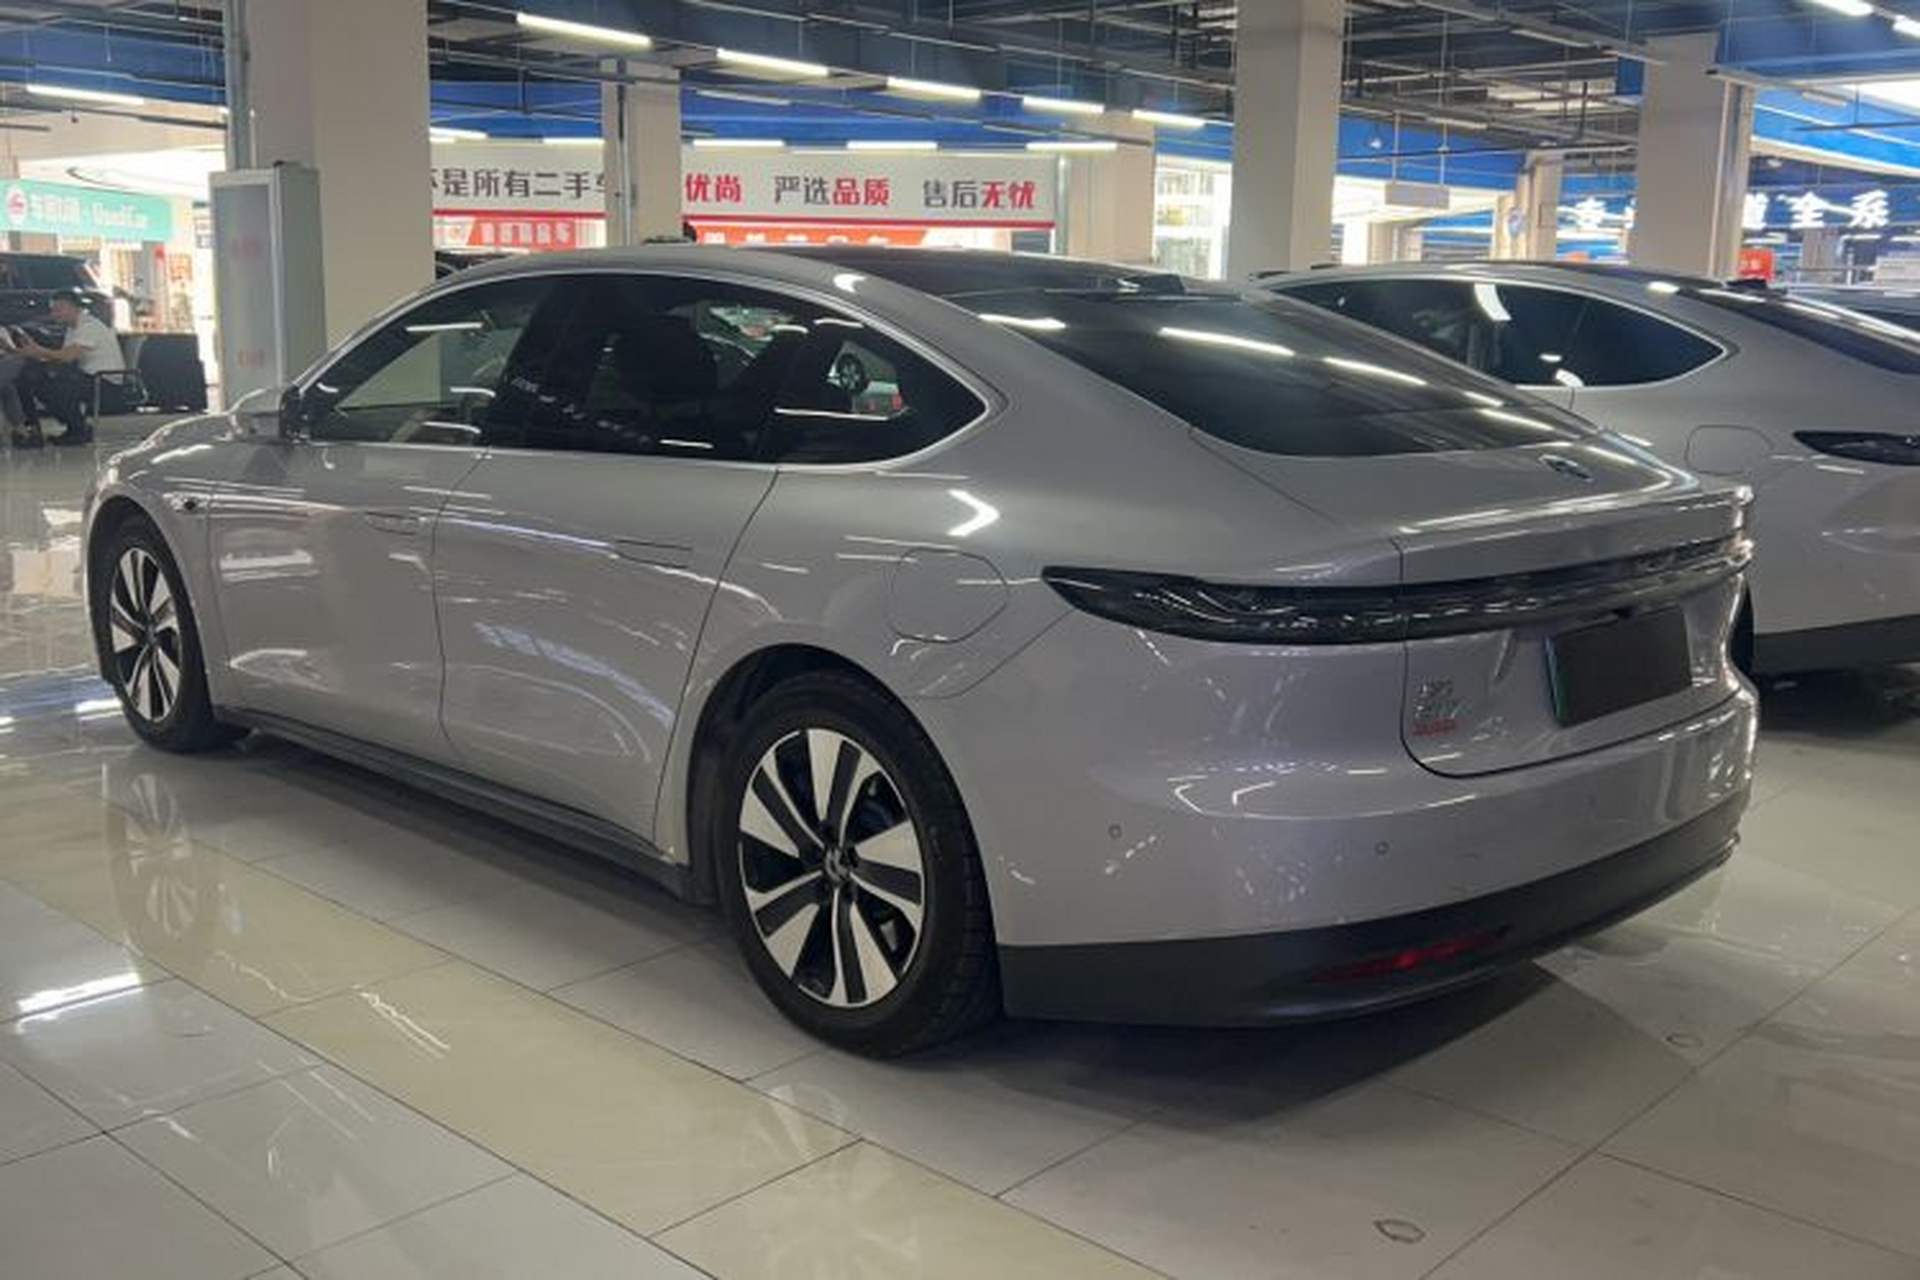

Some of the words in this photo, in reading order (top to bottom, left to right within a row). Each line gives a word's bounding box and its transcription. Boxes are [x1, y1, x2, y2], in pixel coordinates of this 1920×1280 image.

[686, 173, 741, 202] 优尚
[774, 176, 889, 206] 严选品质
[923, 180, 1036, 209] 售后无忧
